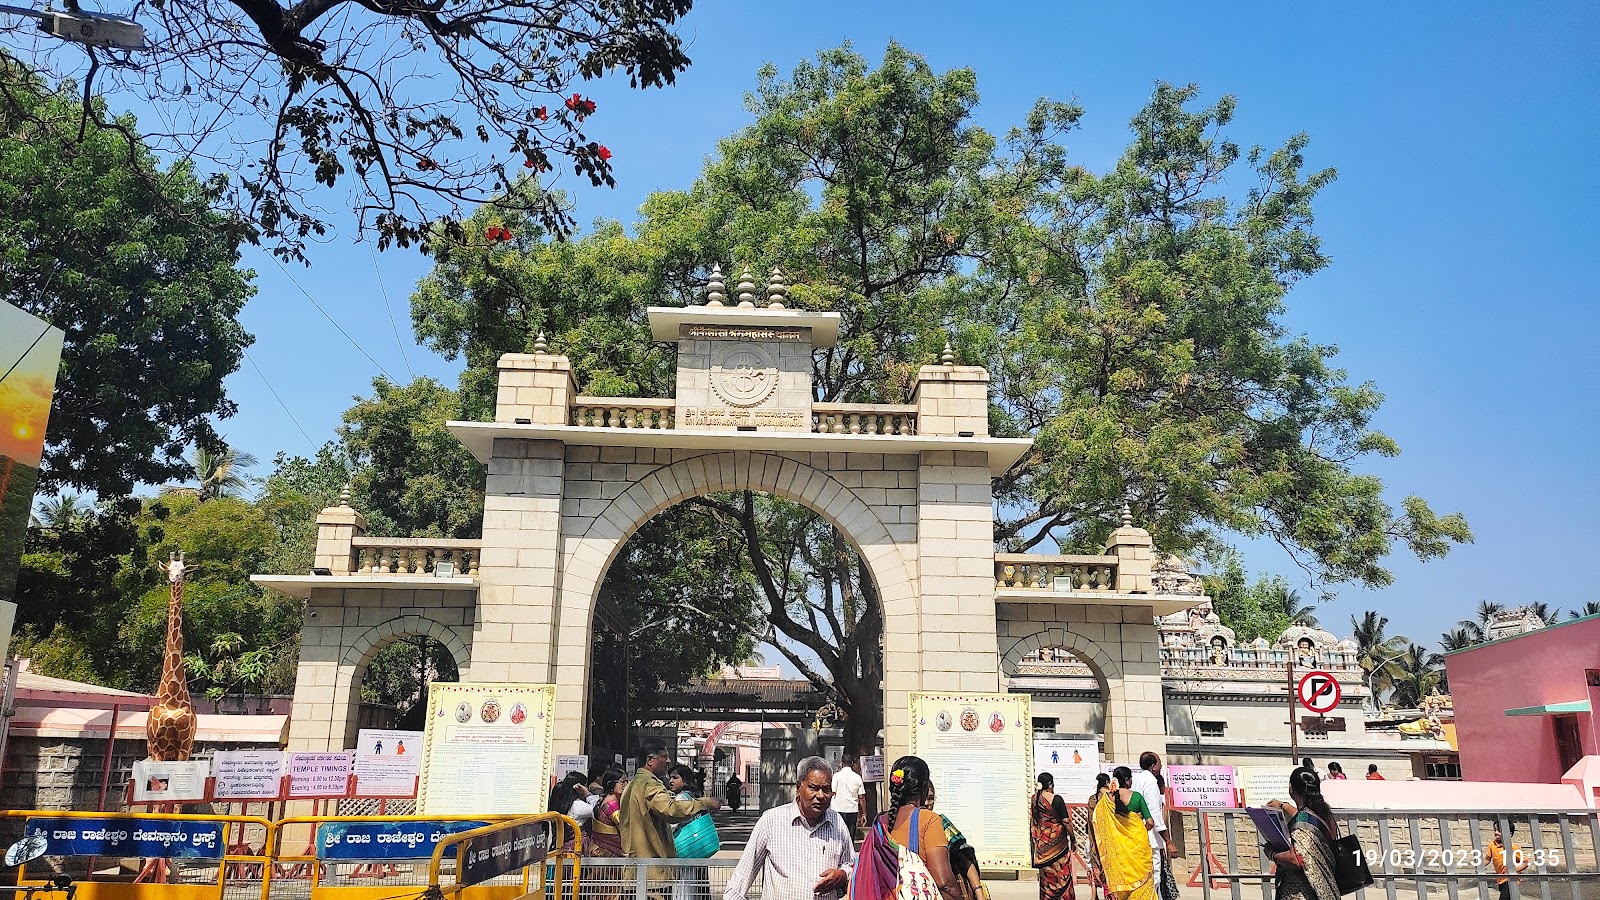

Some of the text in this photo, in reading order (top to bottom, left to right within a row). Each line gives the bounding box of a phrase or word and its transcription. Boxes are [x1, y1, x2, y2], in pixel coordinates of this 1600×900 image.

[1311, 678, 1333, 706] P
[53, 830, 77, 840] ರಾಜ
[82, 828, 128, 846] ರಾಜೇಶ್ವರಿ
[325, 832, 342, 848] ಶ್ರೀ
[347, 834, 371, 844] ರಾಜ
[377, 831, 425, 849] ರಾಜೇಶ್ವರಿ
